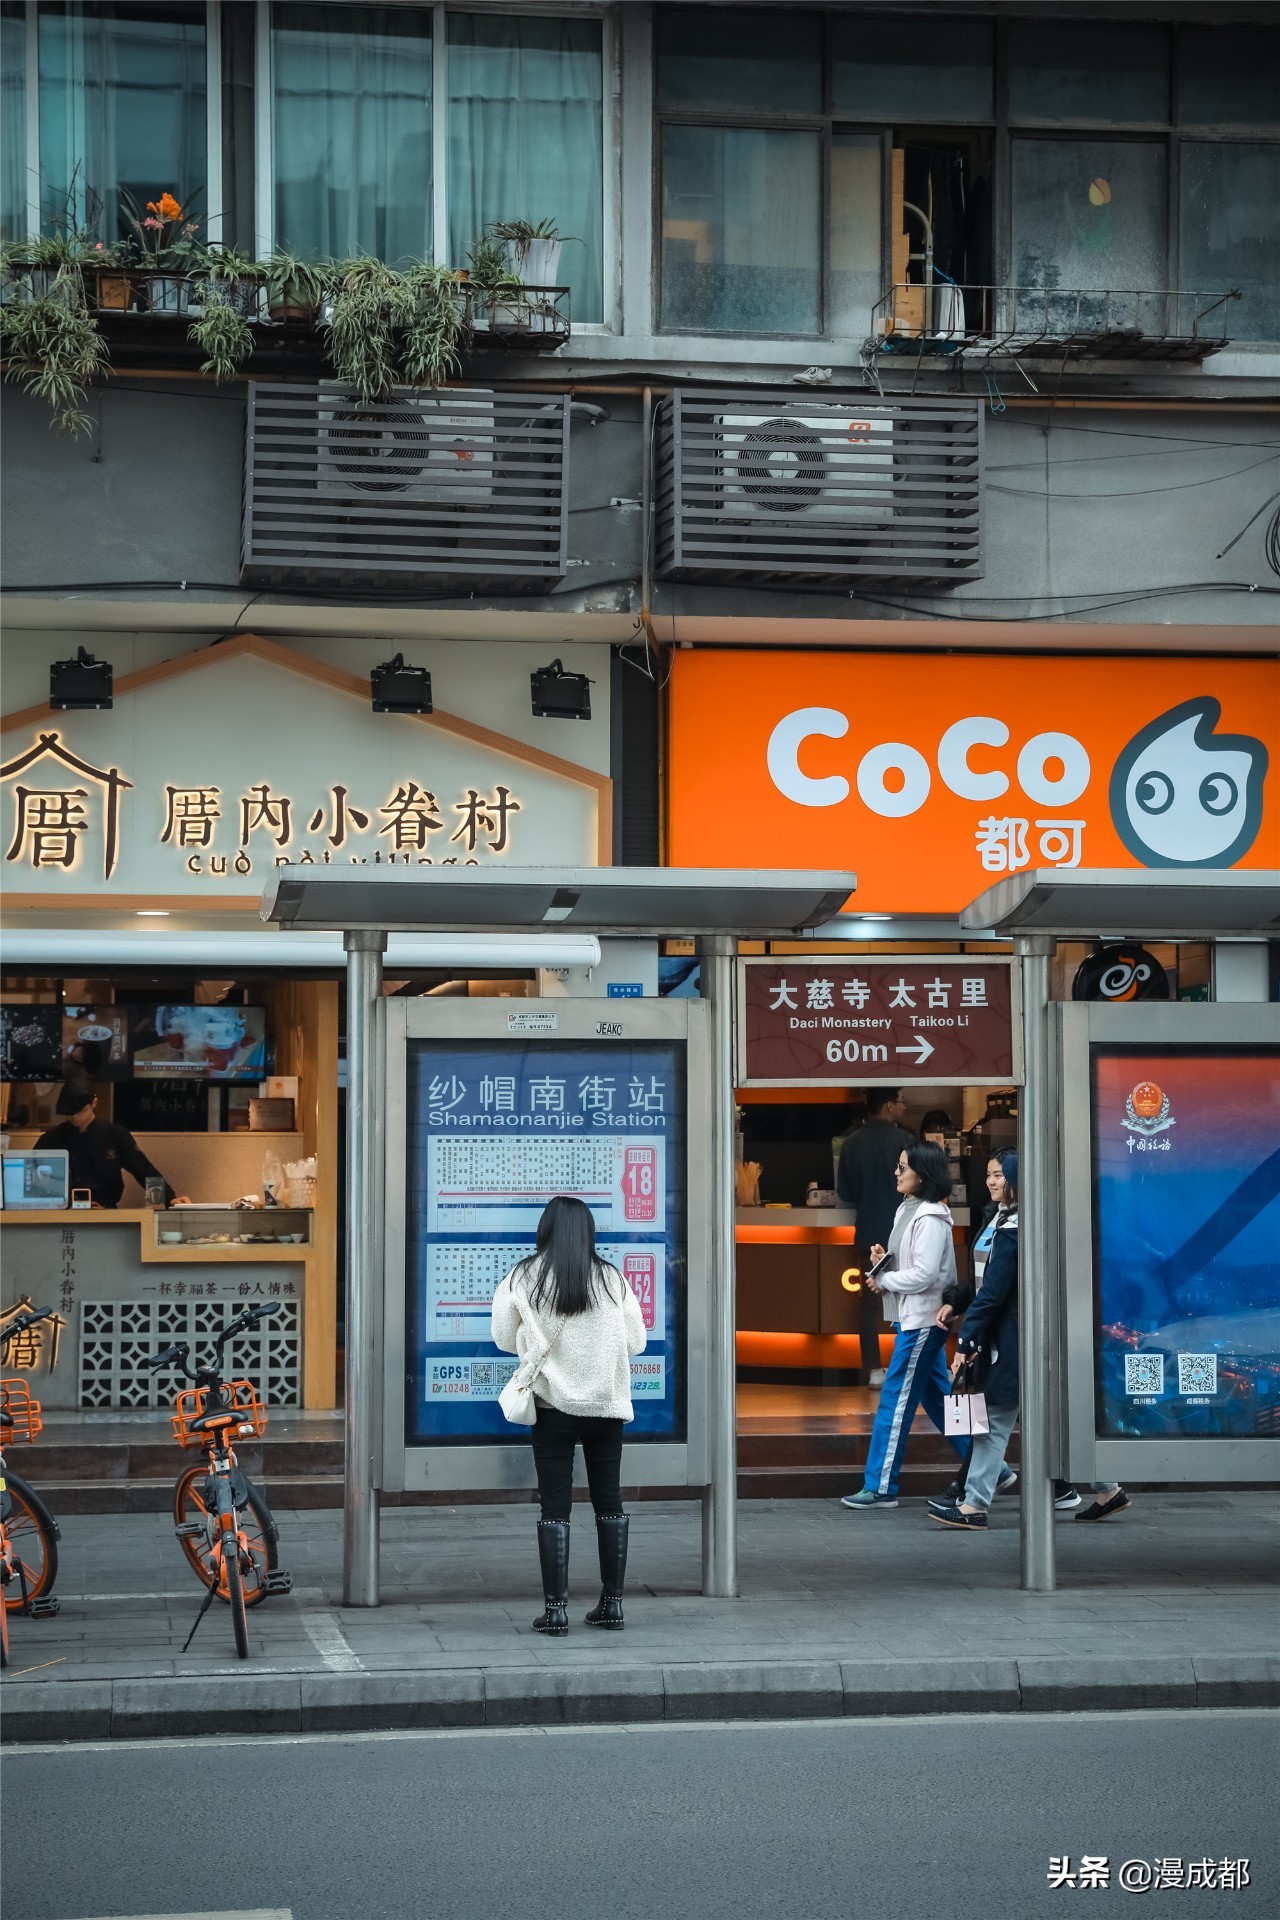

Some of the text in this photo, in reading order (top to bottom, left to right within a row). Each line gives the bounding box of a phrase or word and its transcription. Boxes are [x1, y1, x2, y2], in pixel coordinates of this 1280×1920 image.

[767, 707, 1091, 818] CoCo
[975, 816, 1087, 870] 都可
[769, 977, 989, 1011] 大慈寺 太古里
[789, 1014, 969, 1030] Daci Monastery Taikoo Li
[826, 1039, 888, 1063] 60m
[428, 1074, 666, 1112] 纱帽南街站
[428, 1111, 666, 1129] Shamaonanjie Station
[629, 1165, 652, 1196] 18
[143, 1281, 296, 1296] 一杯幸福茶一份人情味
[439, 1365, 462, 1380] GPS
[443, 1383, 470, 1394] 10248
